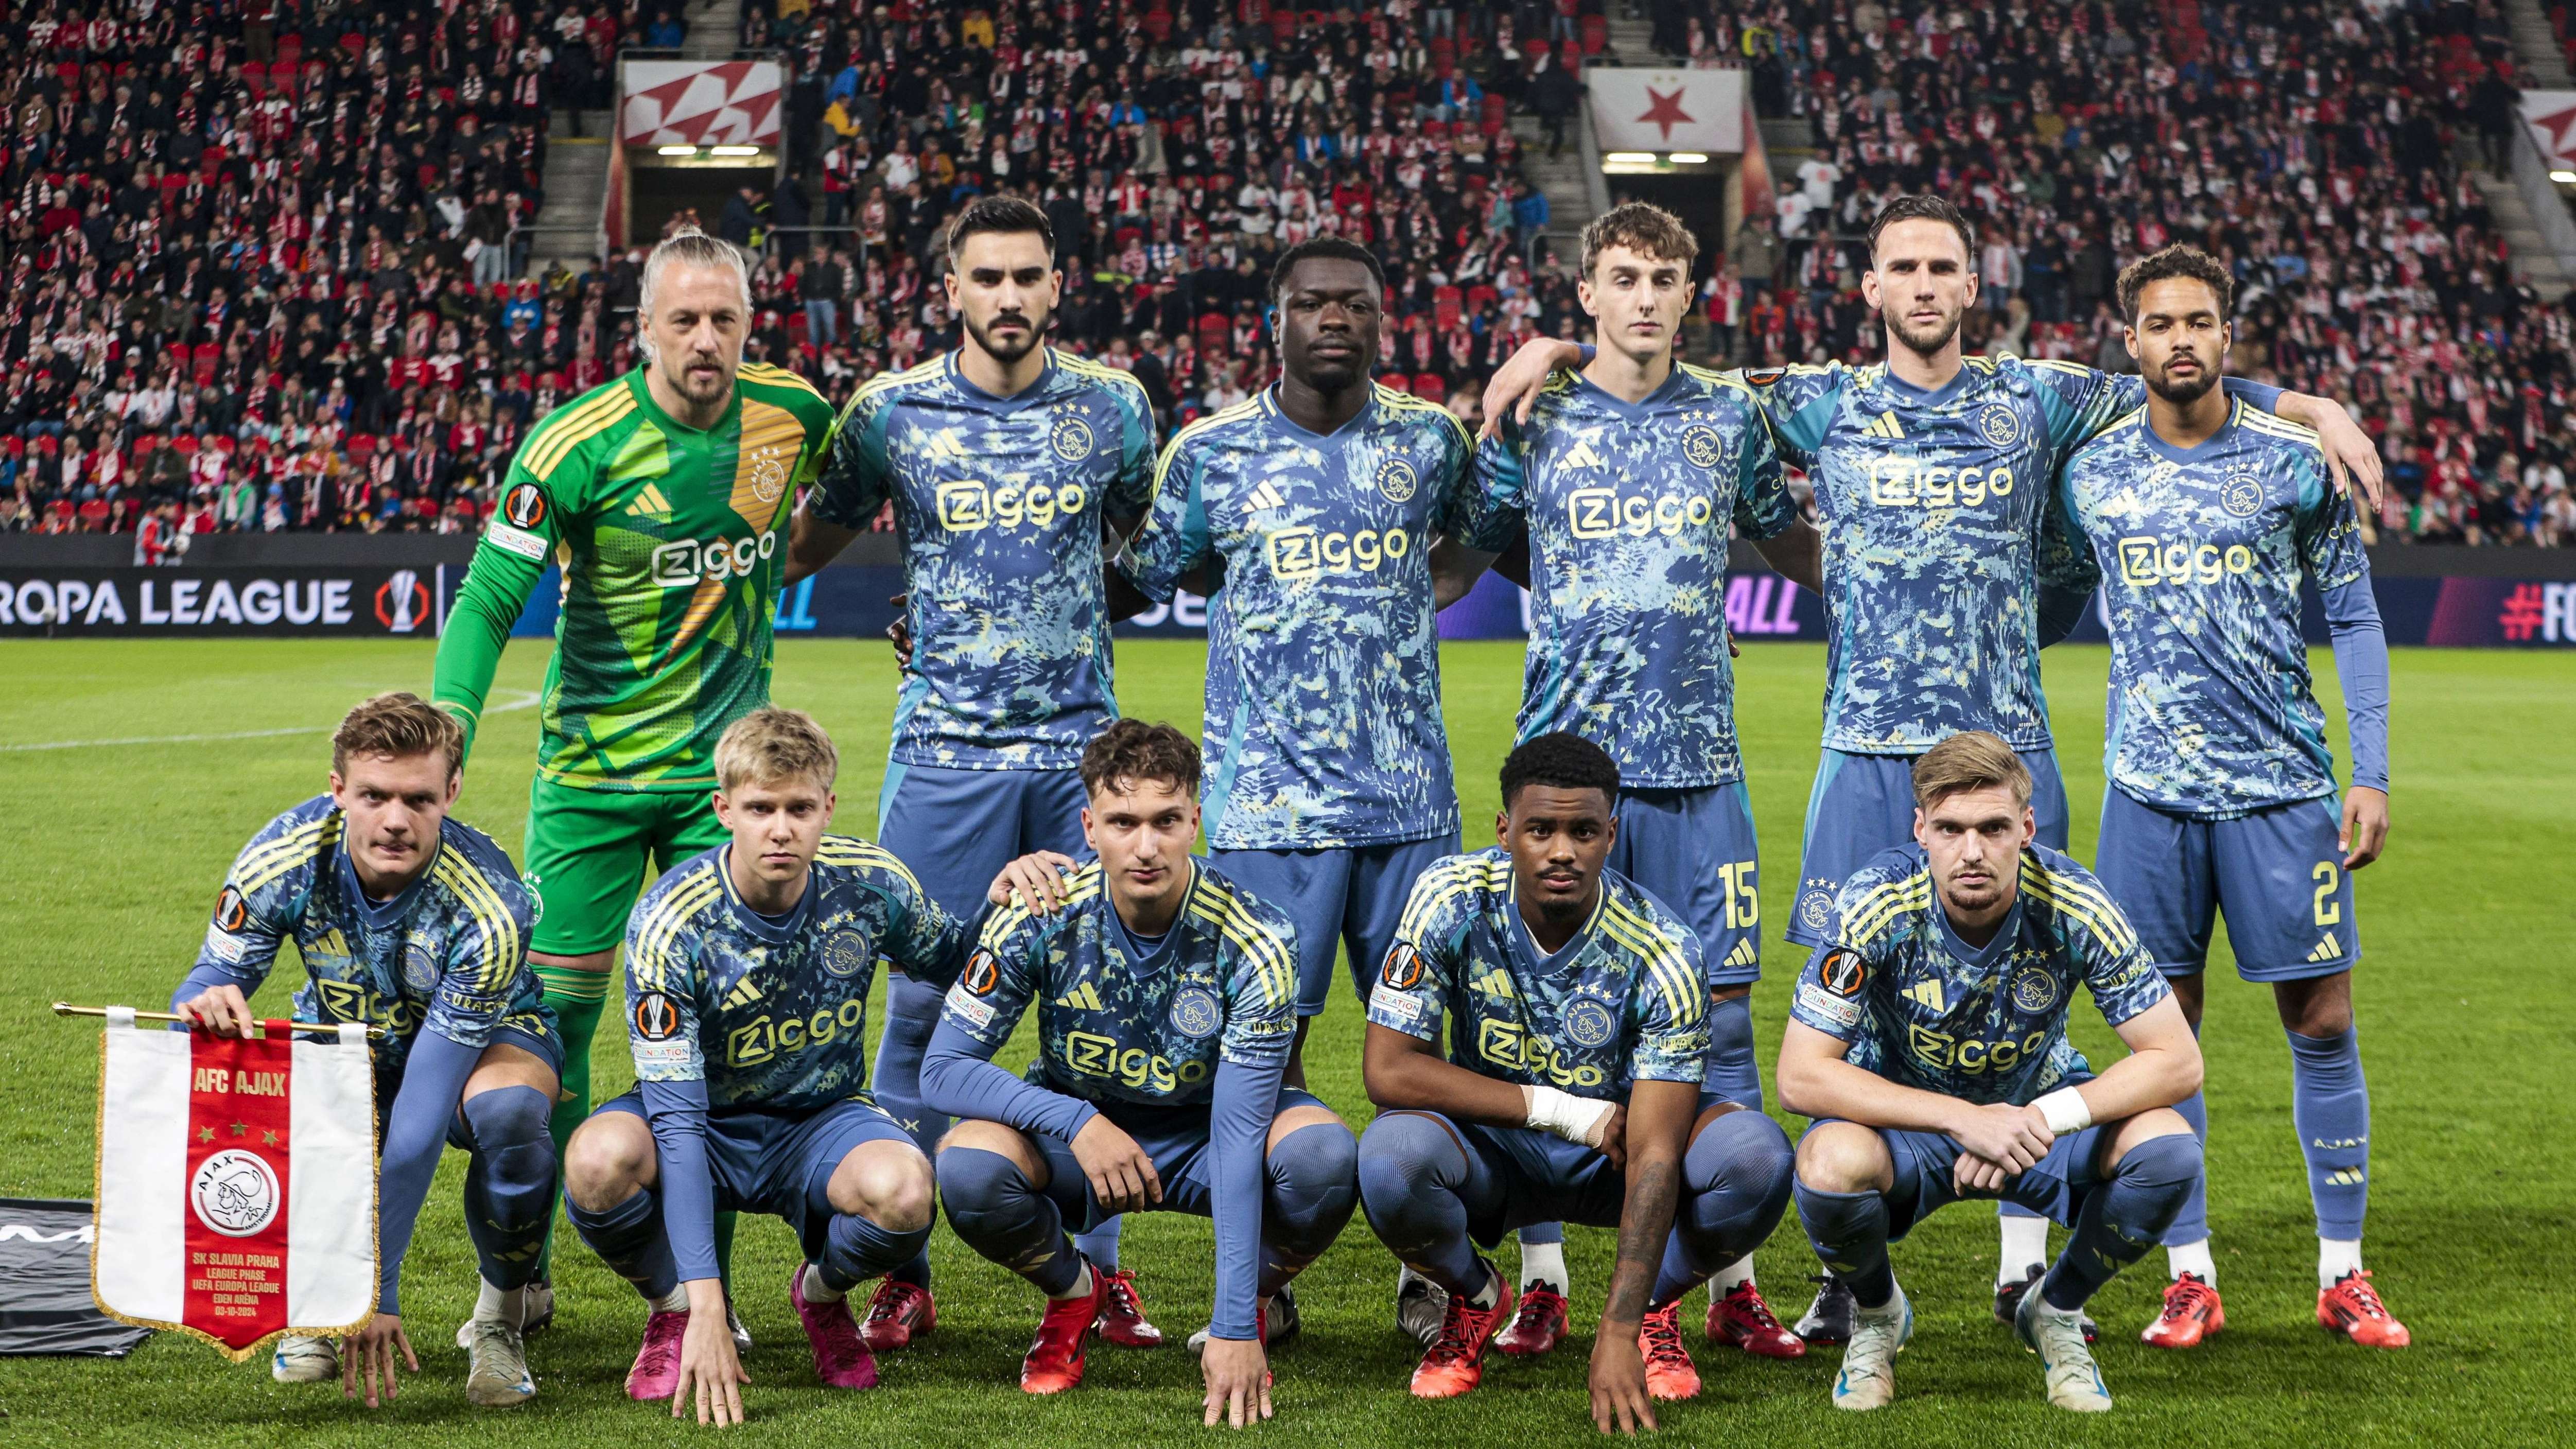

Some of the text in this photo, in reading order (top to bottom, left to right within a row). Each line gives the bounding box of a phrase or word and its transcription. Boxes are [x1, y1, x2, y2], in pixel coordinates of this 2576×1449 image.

[140, 580, 353, 624] LEAGUE
[1718, 861, 1759, 929] 15
[2312, 861, 2340, 927] 2
[824, 933, 840, 957] AJAX
[2010, 968, 2029, 989] AJAX
[1174, 990, 1194, 1009] AJAX
[1568, 1002, 1590, 1019] AJAX
[194, 1068, 286, 1097] AFC AJAX
[199, 1156, 233, 1191] AJAX
[245, 1202, 273, 1231] AMSTERDAM
[193, 1252, 280, 1269] SK SLAVIA PRAHA
[207, 1268, 266, 1281] LEAGUE PHASE
[193, 1279, 280, 1294] UEFA EUROPA LEAGUE
[214, 1293, 259, 1305] EDEN ARÉNA
[215, 1306, 256, 1317] 03-10-2024
